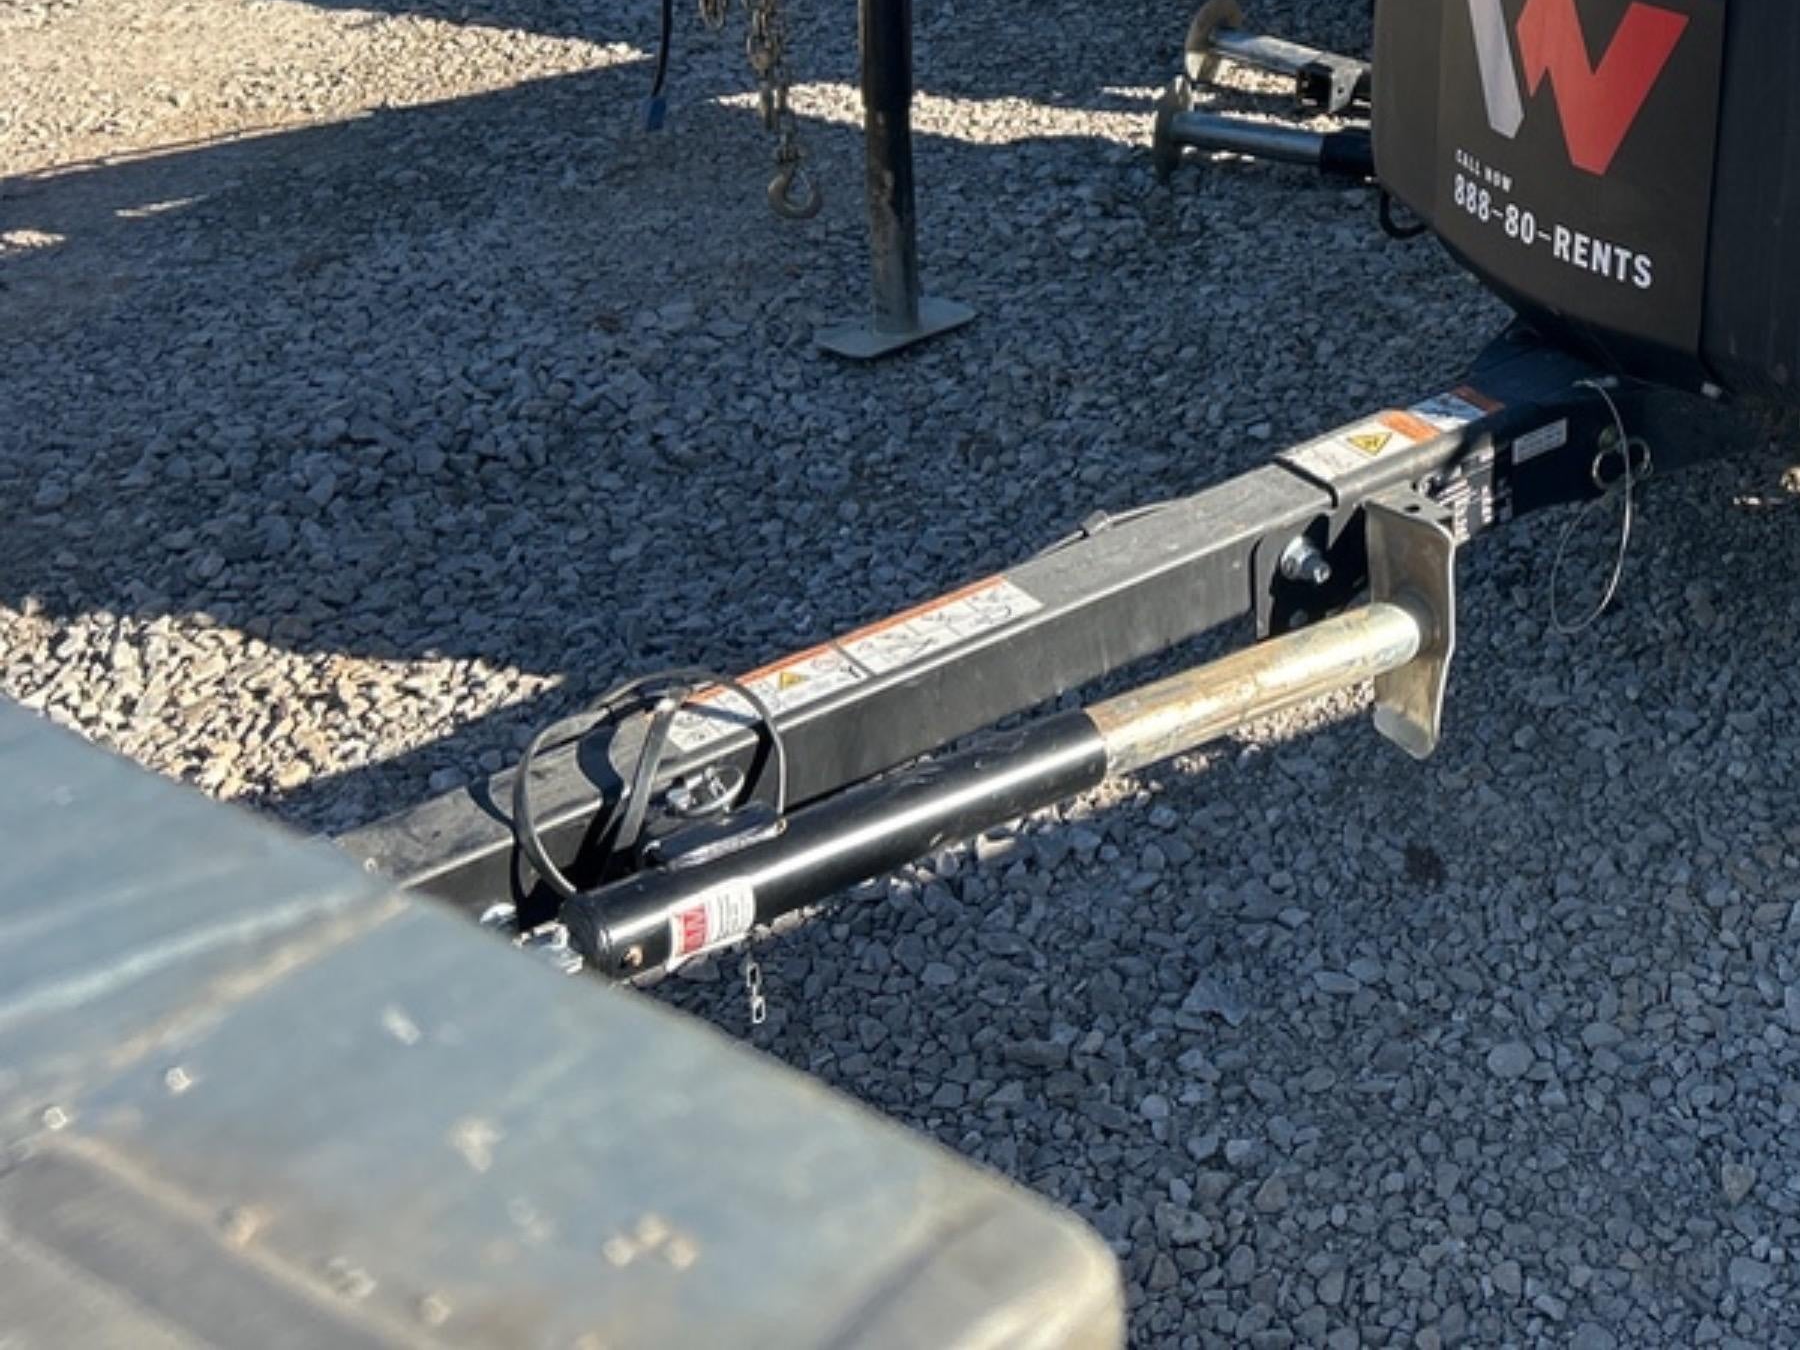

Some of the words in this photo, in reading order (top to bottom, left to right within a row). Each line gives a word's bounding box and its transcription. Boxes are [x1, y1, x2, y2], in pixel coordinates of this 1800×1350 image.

[1455, 149, 1481, 177] CALL
[1484, 166, 1513, 193] NOW
[1453, 173, 1653, 289] 888-80-RENTS
